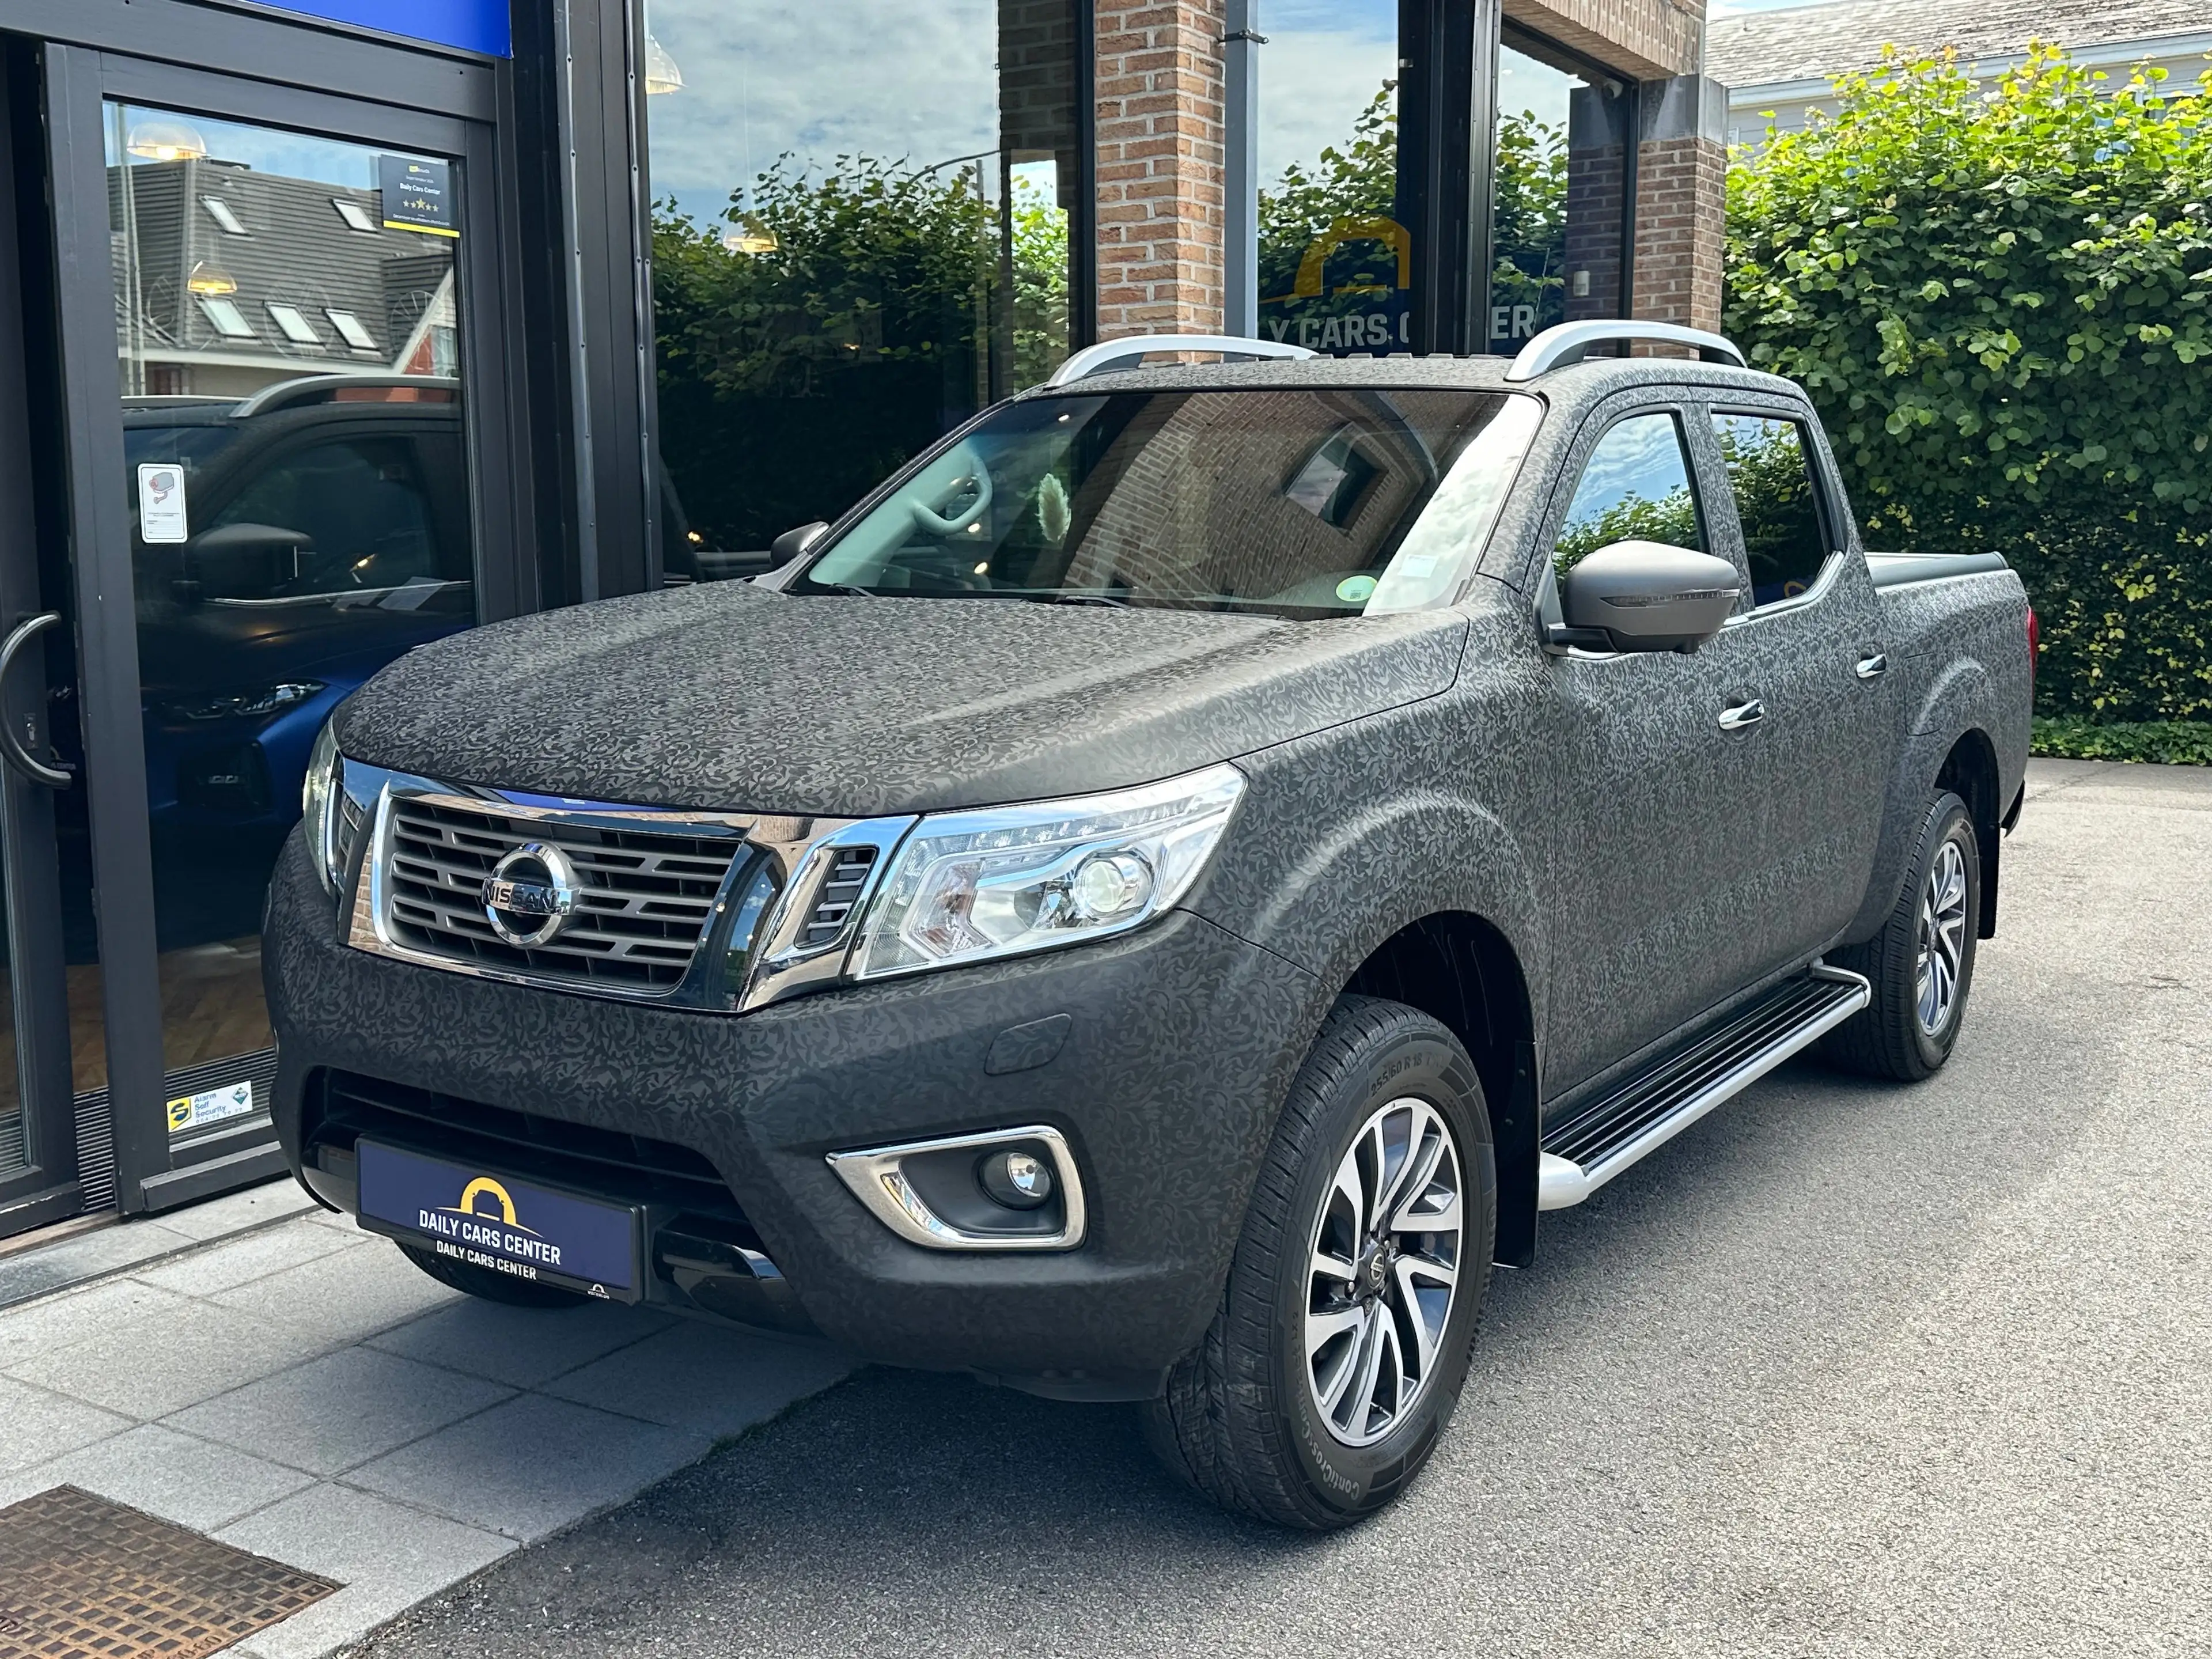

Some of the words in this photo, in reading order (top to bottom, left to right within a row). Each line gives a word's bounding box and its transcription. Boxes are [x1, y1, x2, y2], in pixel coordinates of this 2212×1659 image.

[1299, 313, 1388, 349] CARS
[484, 882, 559, 910] NISSAN
[1404, 1054, 1411, 1071] R
[1412, 1051, 1423, 1067] 18
[194, 1093, 217, 1103] Alarm
[195, 1105, 226, 1118] Security
[419, 1209, 459, 1237] DAILY
[463, 1222, 501, 1248] CARS
[505, 1234, 561, 1266] CENTER
[437, 1240, 465, 1259] DAILY
[467, 1249, 495, 1268] CARS
[497, 1258, 537, 1280] CENTER
